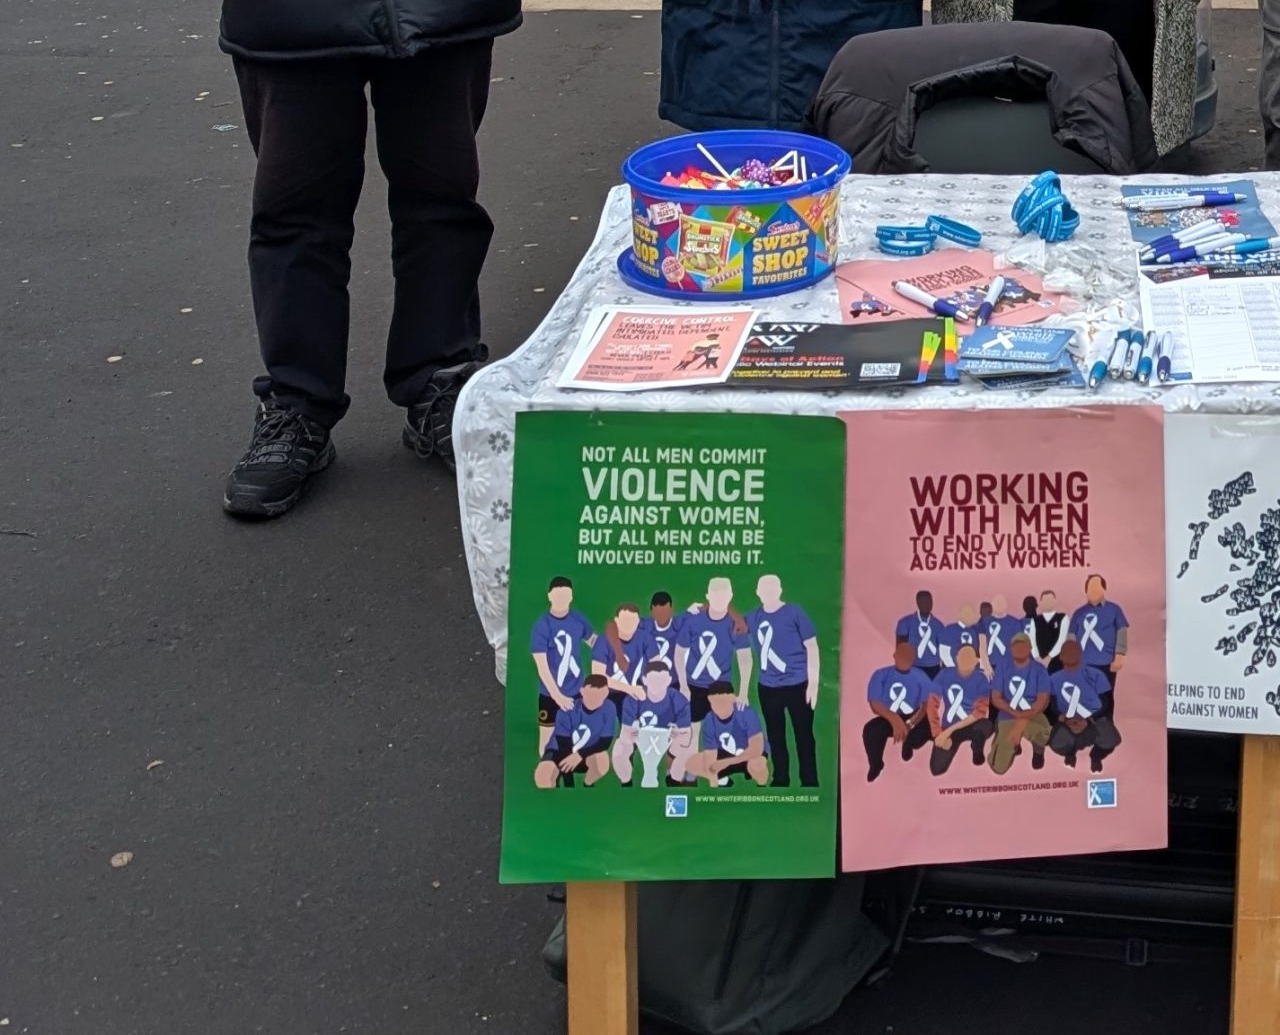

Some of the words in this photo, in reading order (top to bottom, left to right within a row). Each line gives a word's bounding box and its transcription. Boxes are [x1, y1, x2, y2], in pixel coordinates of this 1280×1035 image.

[752, 229, 810, 253] SWEET
[752, 246, 809, 274] SHOP
[752, 267, 808, 285] FAVOURITES
[622, 316, 678, 325] COERCIVE
[683, 315, 737, 324] CONTROL
[582, 446, 616, 463] NOT
[621, 447, 650, 464] ALL
[656, 448, 693, 464] MEN
[699, 448, 767, 464] COMMIT
[581, 467, 765, 502] VIOLENCE
[909, 471, 1089, 507] WORKING
[579, 505, 671, 525] AGAINST
[679, 507, 766, 527] WOMEN,
[910, 505, 1000, 536] WITH
[1015, 503, 1089, 534] MEN
[578, 529, 613, 545] BUT
[618, 529, 648, 545] ALL
[655, 530, 692, 546] MEN
[698, 530, 736, 546] CAN
[742, 530, 765, 545] BE
[909, 536, 935, 554] TO
[943, 534, 983, 553] END
[992, 532, 1091, 552] VIOLENCE
[577, 550, 655, 565] INVOLVED
[660, 550, 676, 565] IN
[682, 550, 742, 564] ENDING
[747, 550, 764, 565] IT.
[909, 551, 999, 571] AGAINST
[1007, 549, 1092, 569] WOMEN.
[1166, 684, 1204, 699] ELPING
[1207, 685, 1222, 699] TO
[1224, 686, 1245, 700] END
[1171, 701, 1217, 717] AGAINST
[1218, 704, 1259, 720] WOMEN
